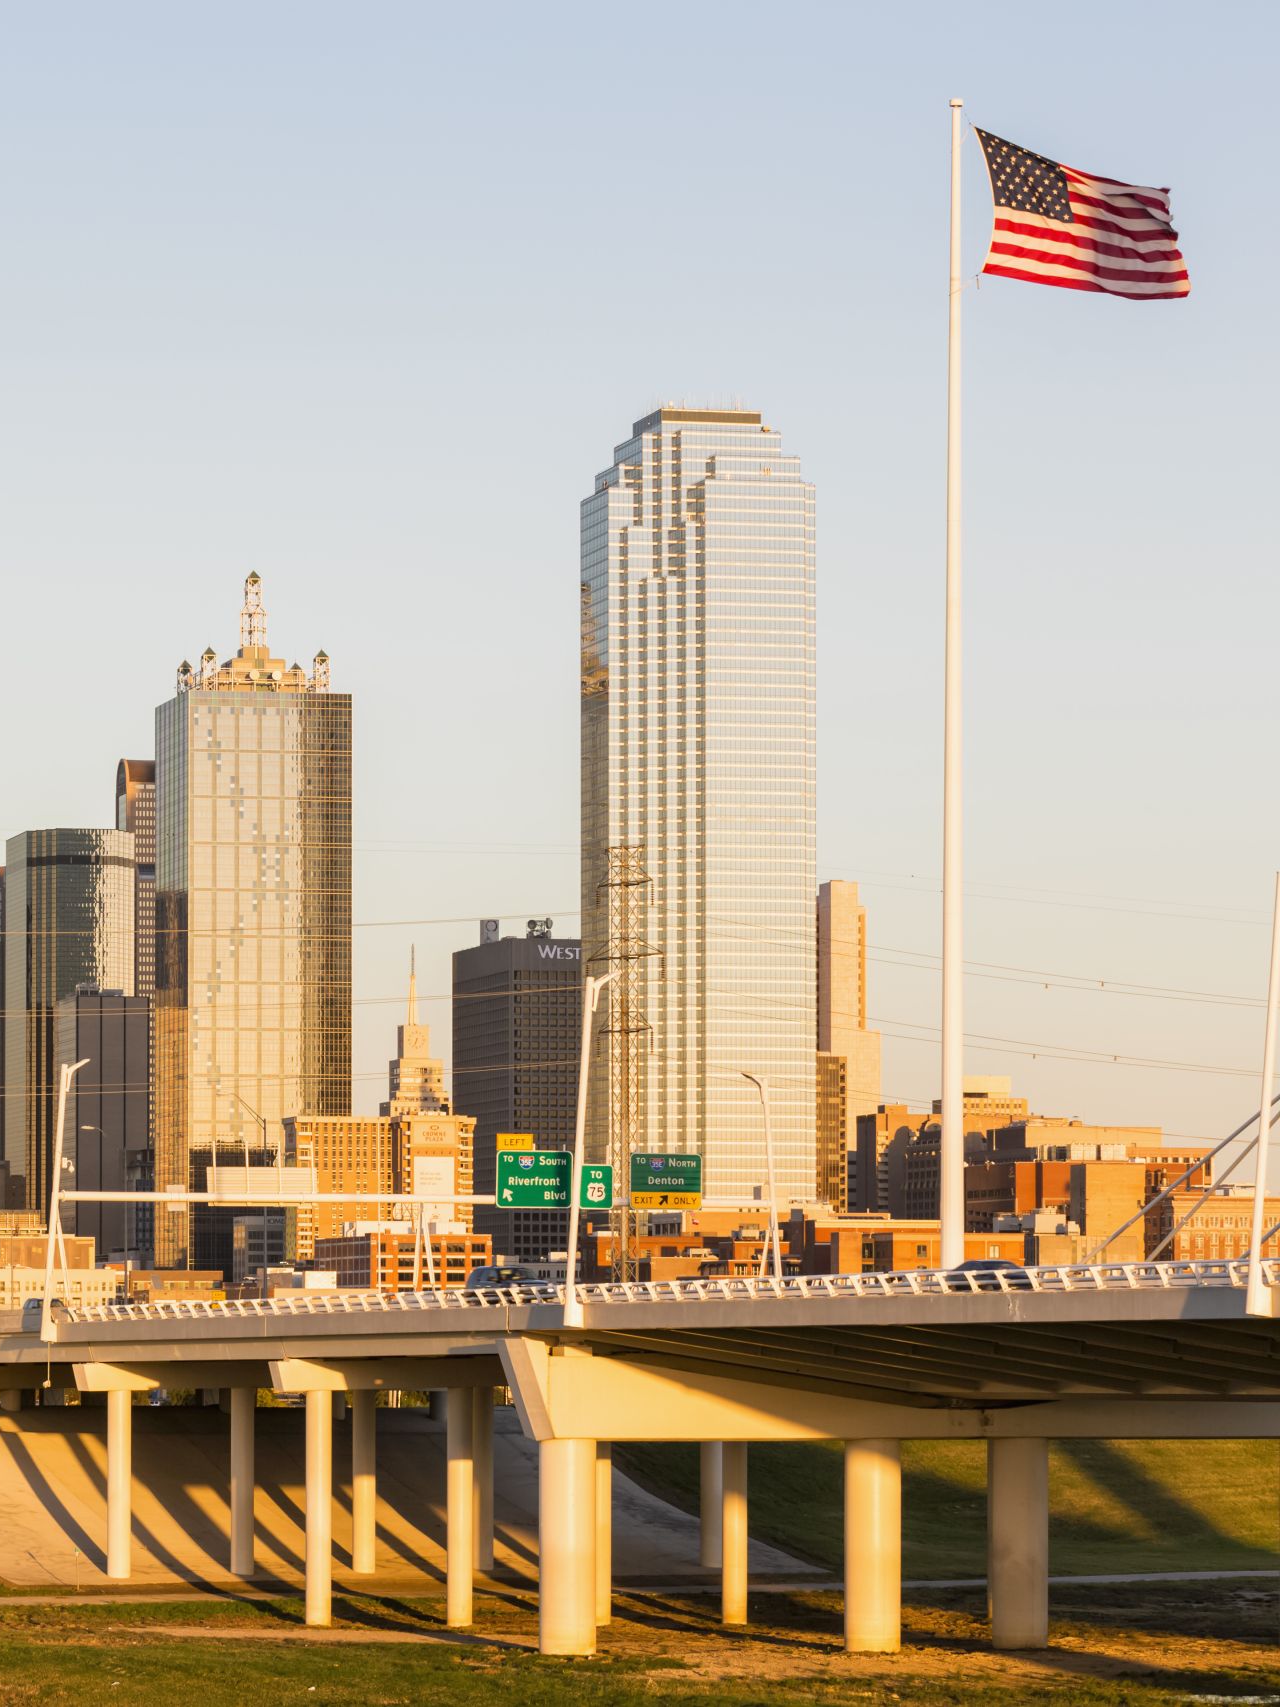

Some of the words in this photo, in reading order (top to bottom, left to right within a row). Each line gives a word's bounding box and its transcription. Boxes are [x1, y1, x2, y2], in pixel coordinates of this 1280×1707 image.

[504, 1138, 525, 1146] LEFT
[539, 1156, 567, 1166] SOUTH
[668, 1158, 696, 1168] NORTH
[508, 1176, 560, 1186] Riverfront
[648, 1176, 684, 1185] Denton
[544, 1191, 566, 1200] Blvd
[589, 1186, 604, 1198] 75
[634, 1196, 653, 1205] EXIT
[674, 1196, 697, 1205] ONLY
